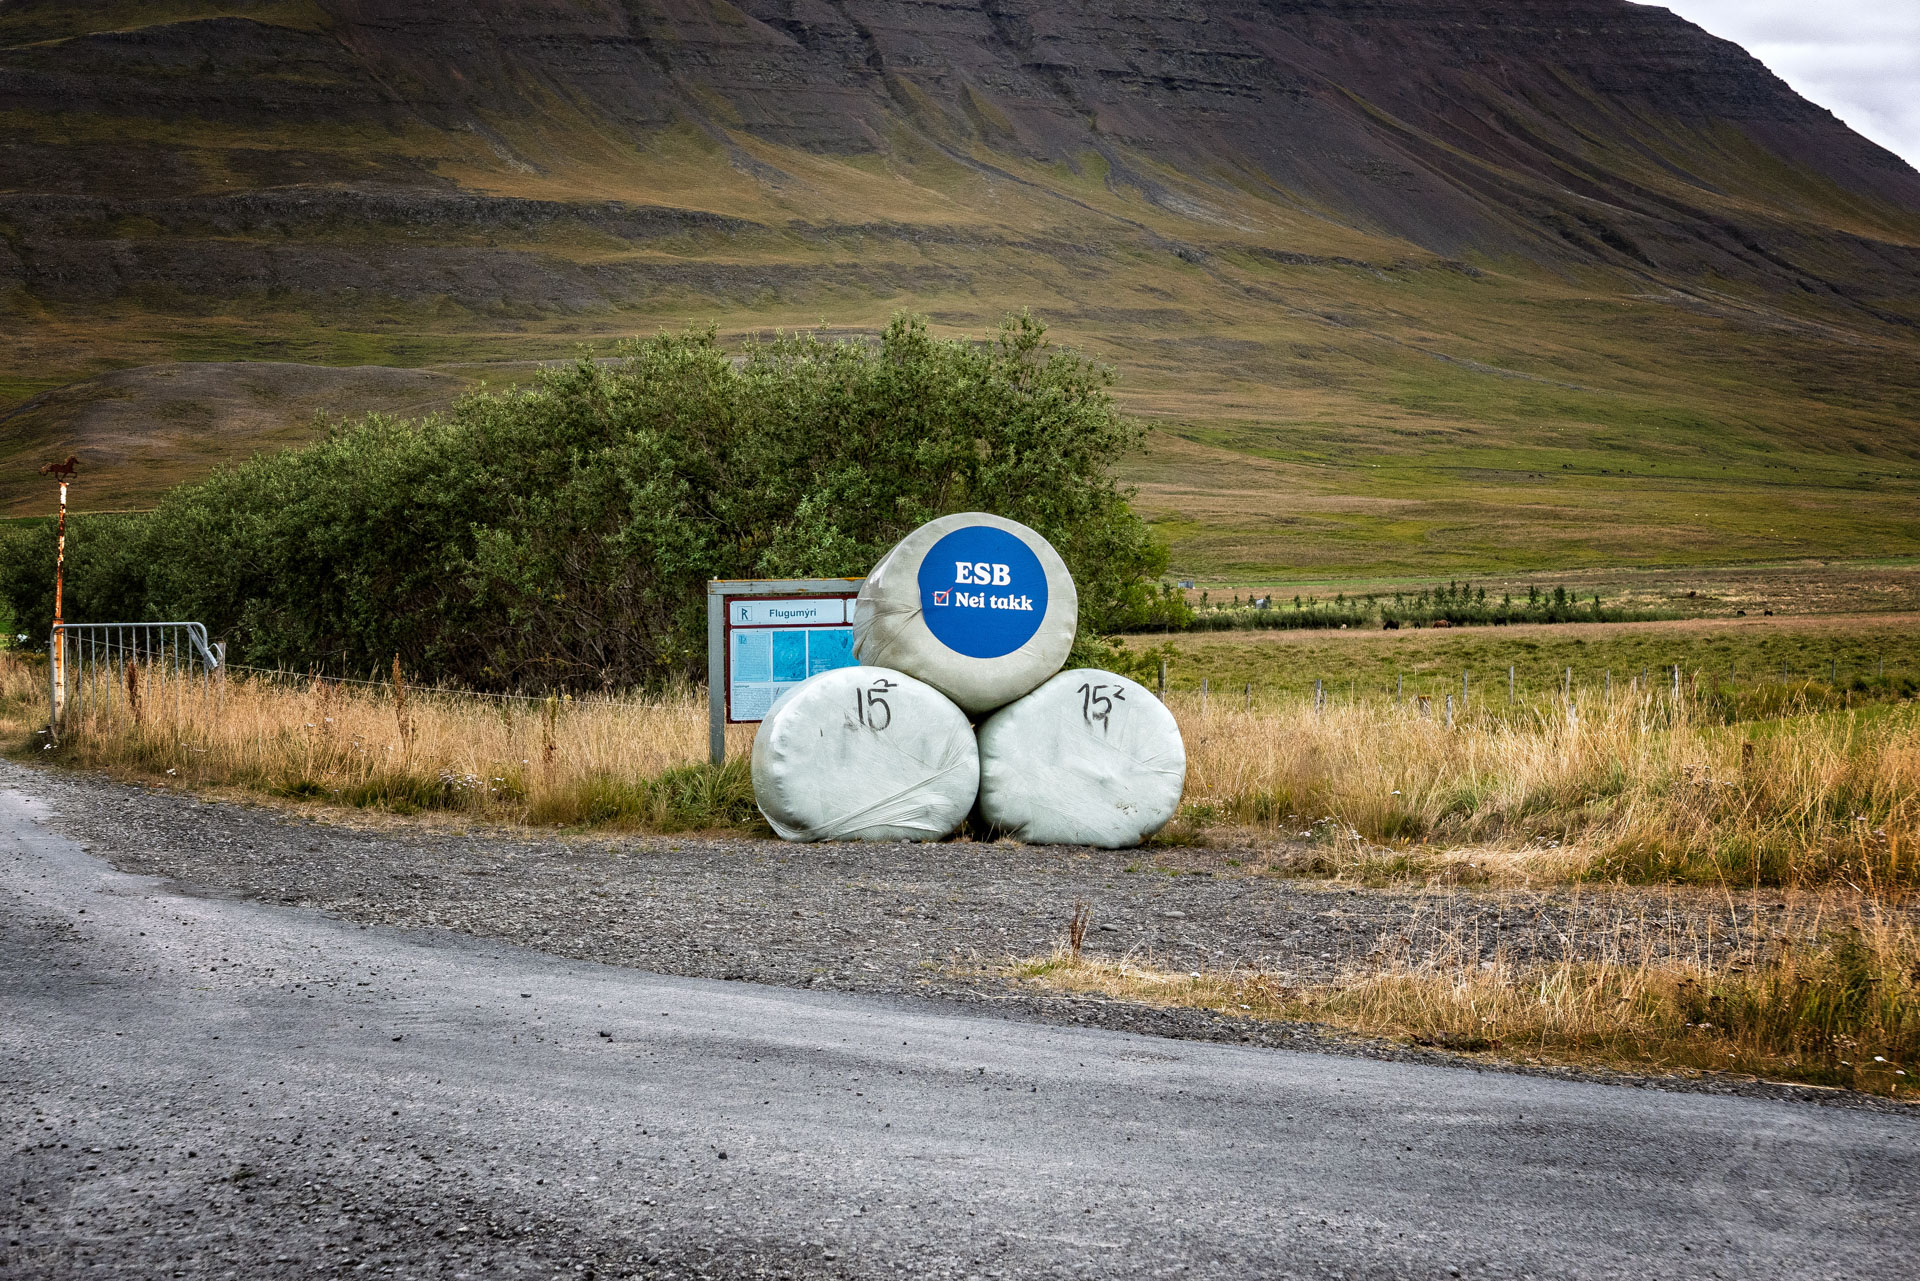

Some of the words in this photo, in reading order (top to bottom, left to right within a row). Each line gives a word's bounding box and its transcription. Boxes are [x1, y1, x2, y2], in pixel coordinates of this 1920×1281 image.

[955, 561, 1011, 586] ESB
[955, 592, 985, 608] Nei
[989, 594, 1033, 611] takk
[769, 608, 817, 619] Flugumýri
